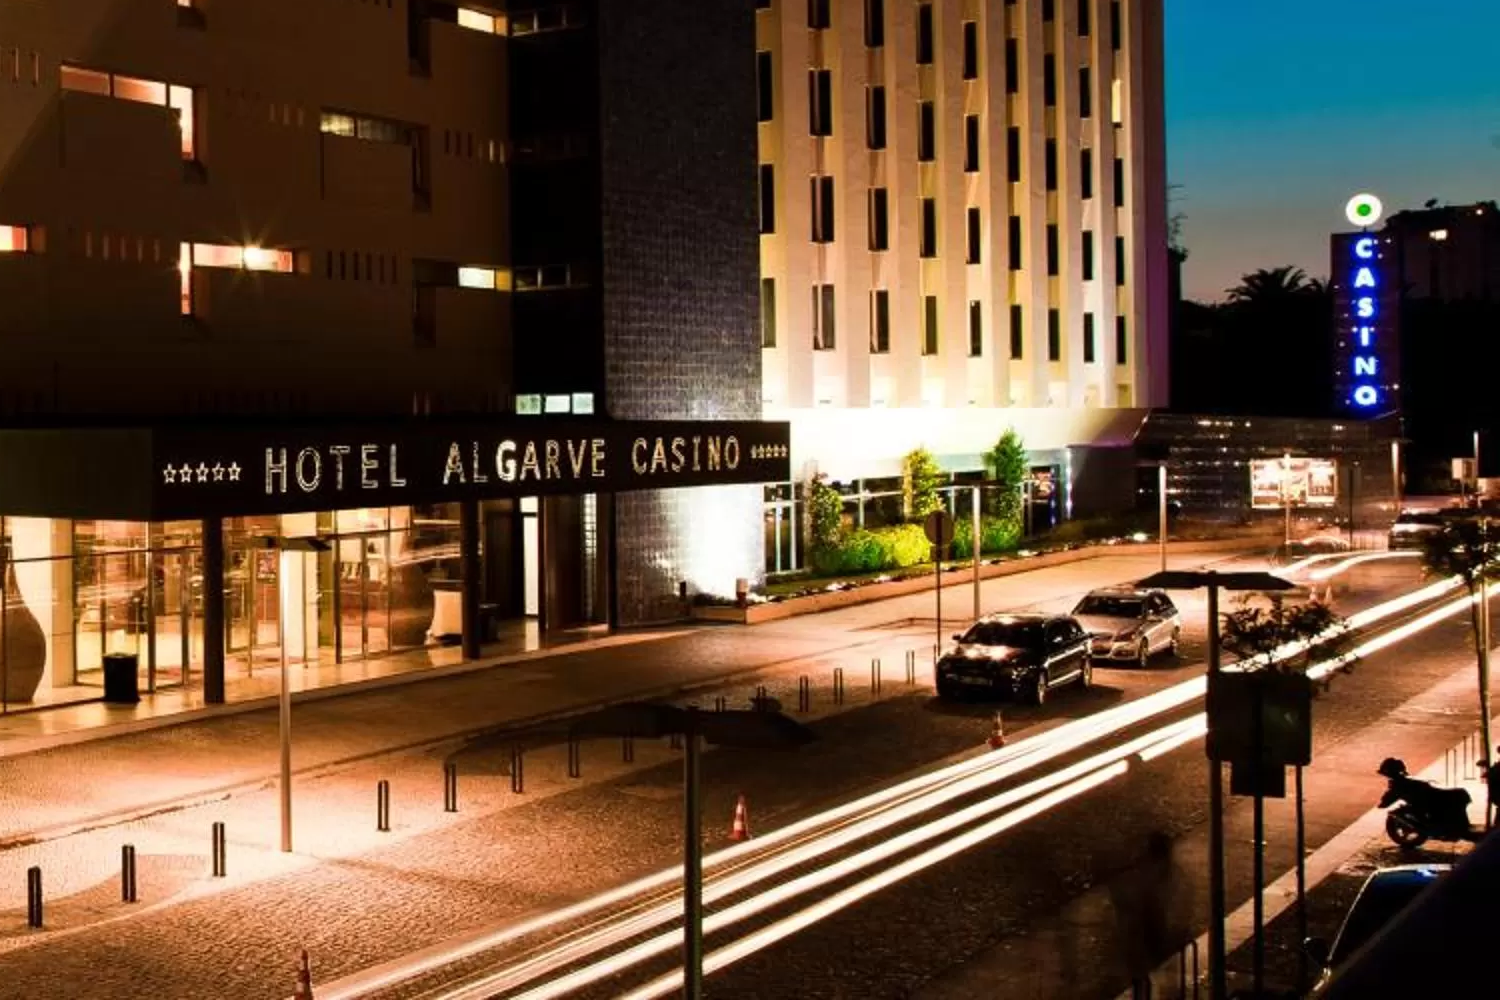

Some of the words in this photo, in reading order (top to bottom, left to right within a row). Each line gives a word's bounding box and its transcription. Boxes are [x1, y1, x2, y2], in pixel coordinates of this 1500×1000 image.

[1354, 238, 1377, 405] CASINO
[265, 445, 407, 494] HOTEL
[442, 438, 605, 485] ALGARVE
[631, 435, 740, 475] CASINO
